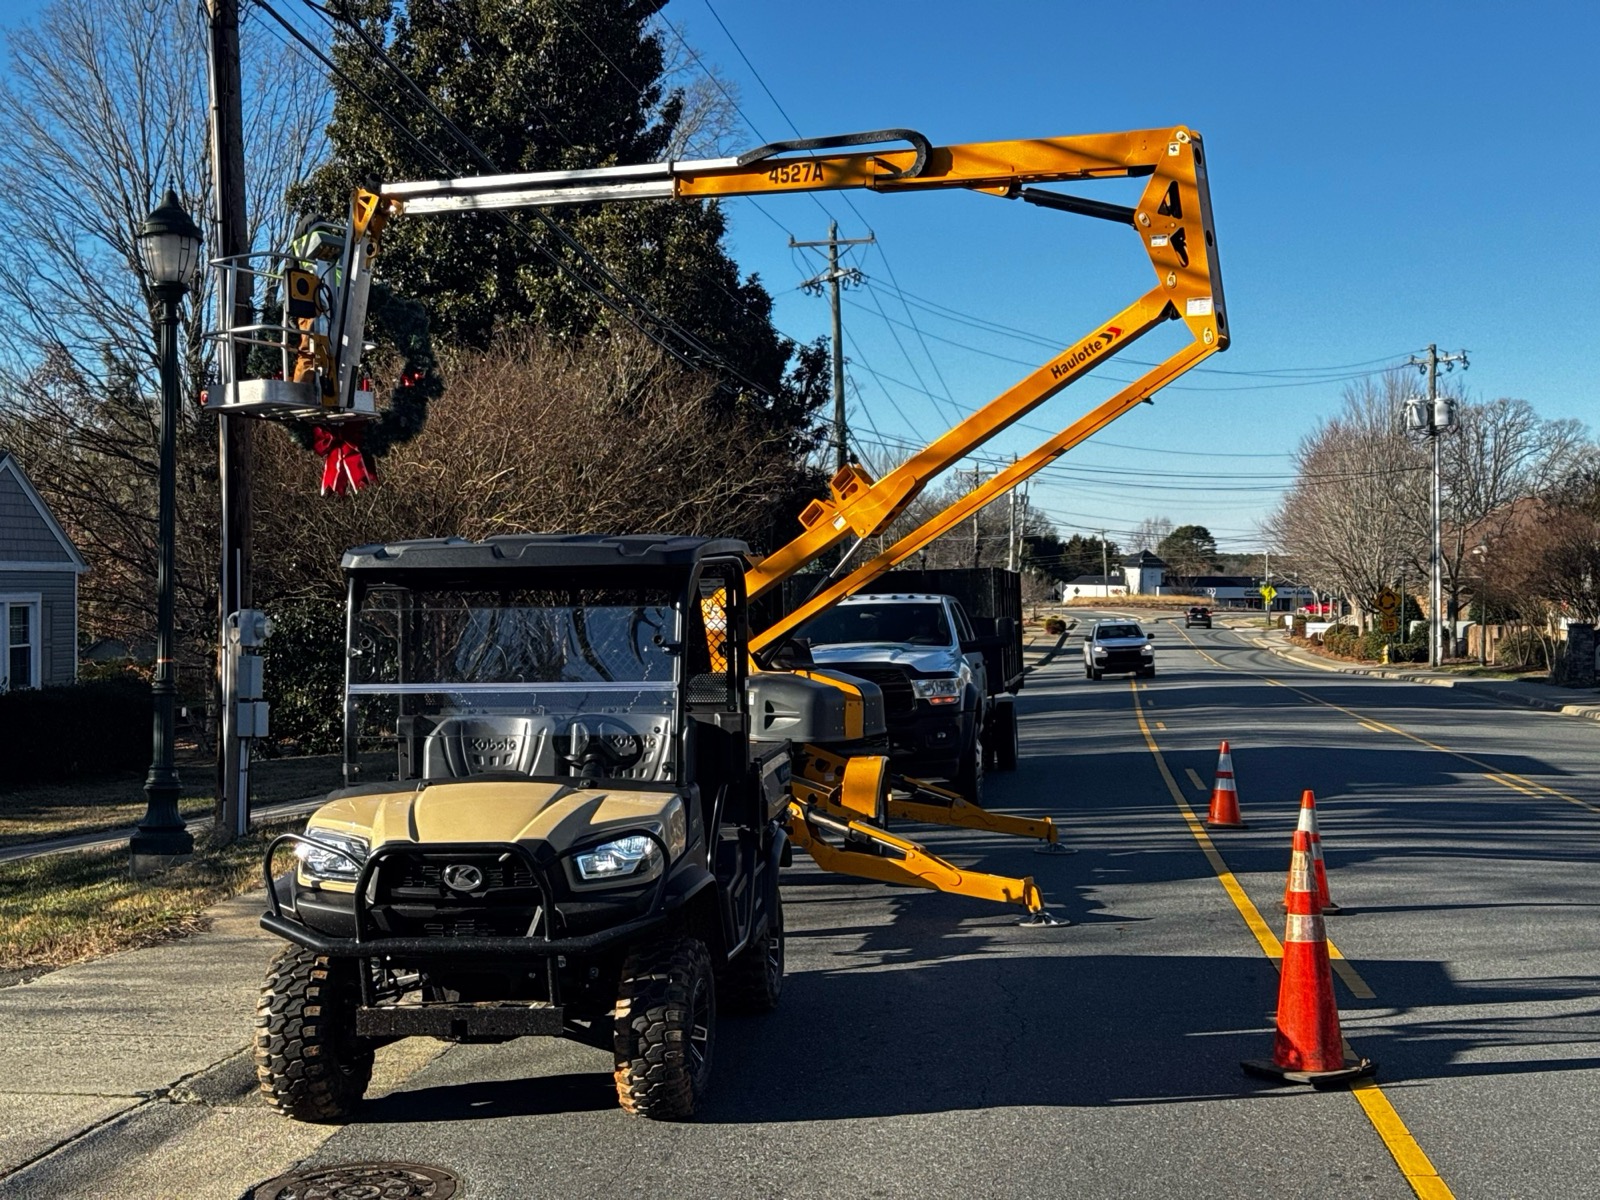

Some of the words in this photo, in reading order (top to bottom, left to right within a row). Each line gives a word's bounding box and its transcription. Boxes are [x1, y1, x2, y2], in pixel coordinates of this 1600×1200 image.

[768, 162, 824, 184] 4527A
[1050, 340, 1103, 380] Haulotte
[471, 738, 518, 752] Kubota
[610, 734, 657, 749] Kubta
